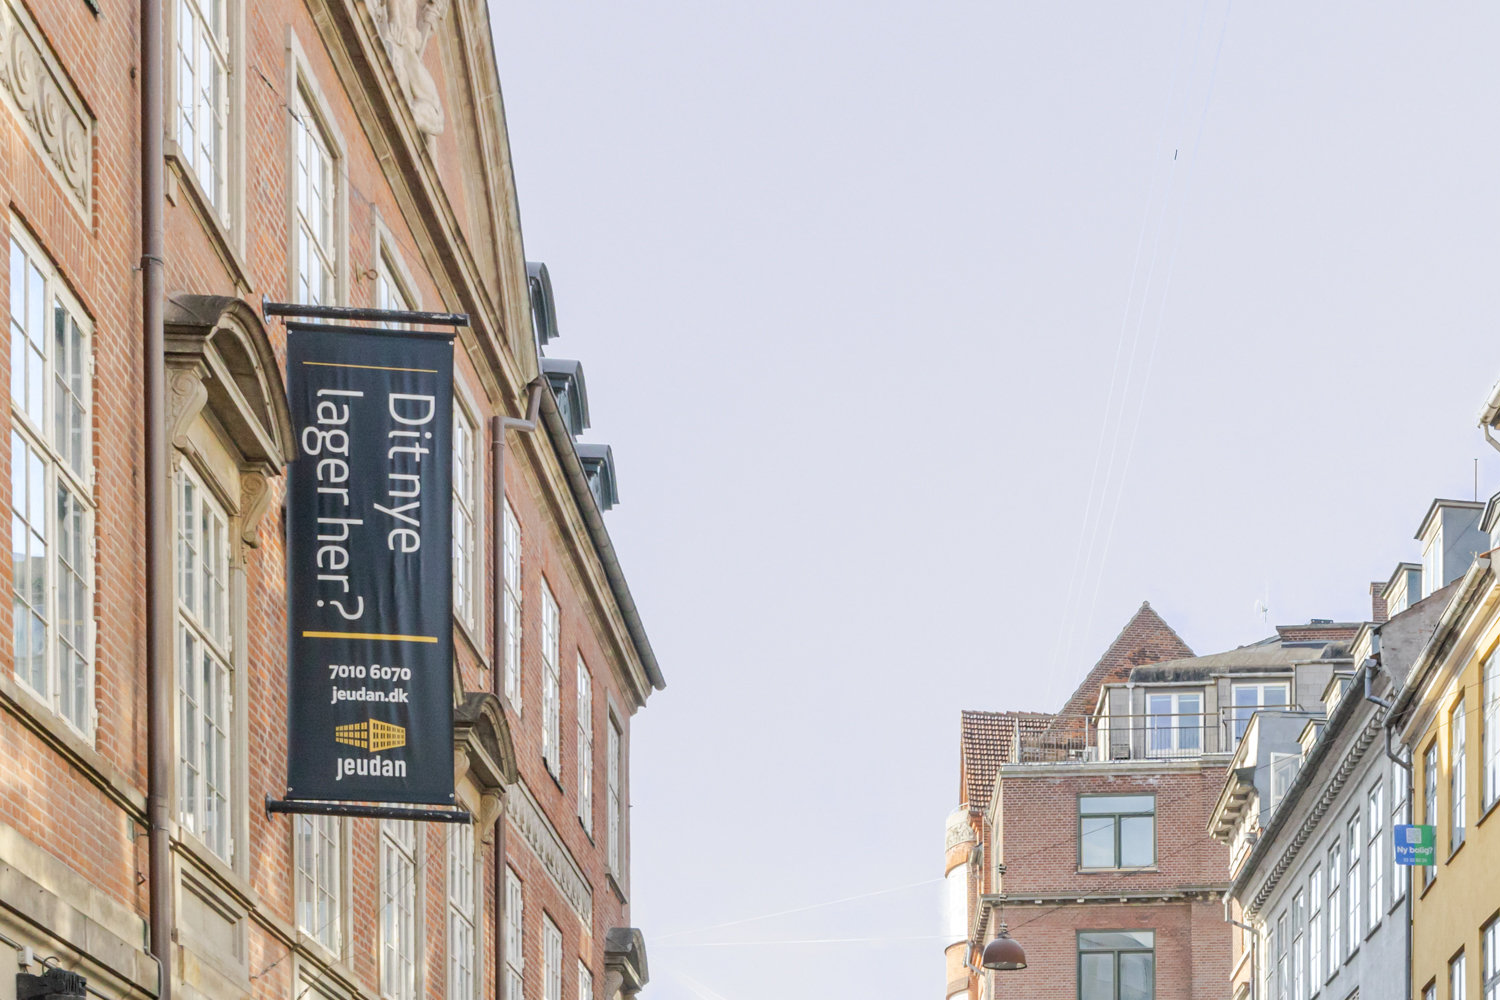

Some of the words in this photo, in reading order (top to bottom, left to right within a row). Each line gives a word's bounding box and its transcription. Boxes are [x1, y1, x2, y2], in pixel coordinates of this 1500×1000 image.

[301, 388, 364, 507] lager
[388, 392, 436, 461] Dit
[373, 473, 422, 555] nye
[316, 517, 364, 621] her?
[328, 663, 367, 682] 7010
[369, 664, 412, 683] 6070
[331, 685, 409, 705] jeudan.dk
[335, 755, 407, 781] jeudan
